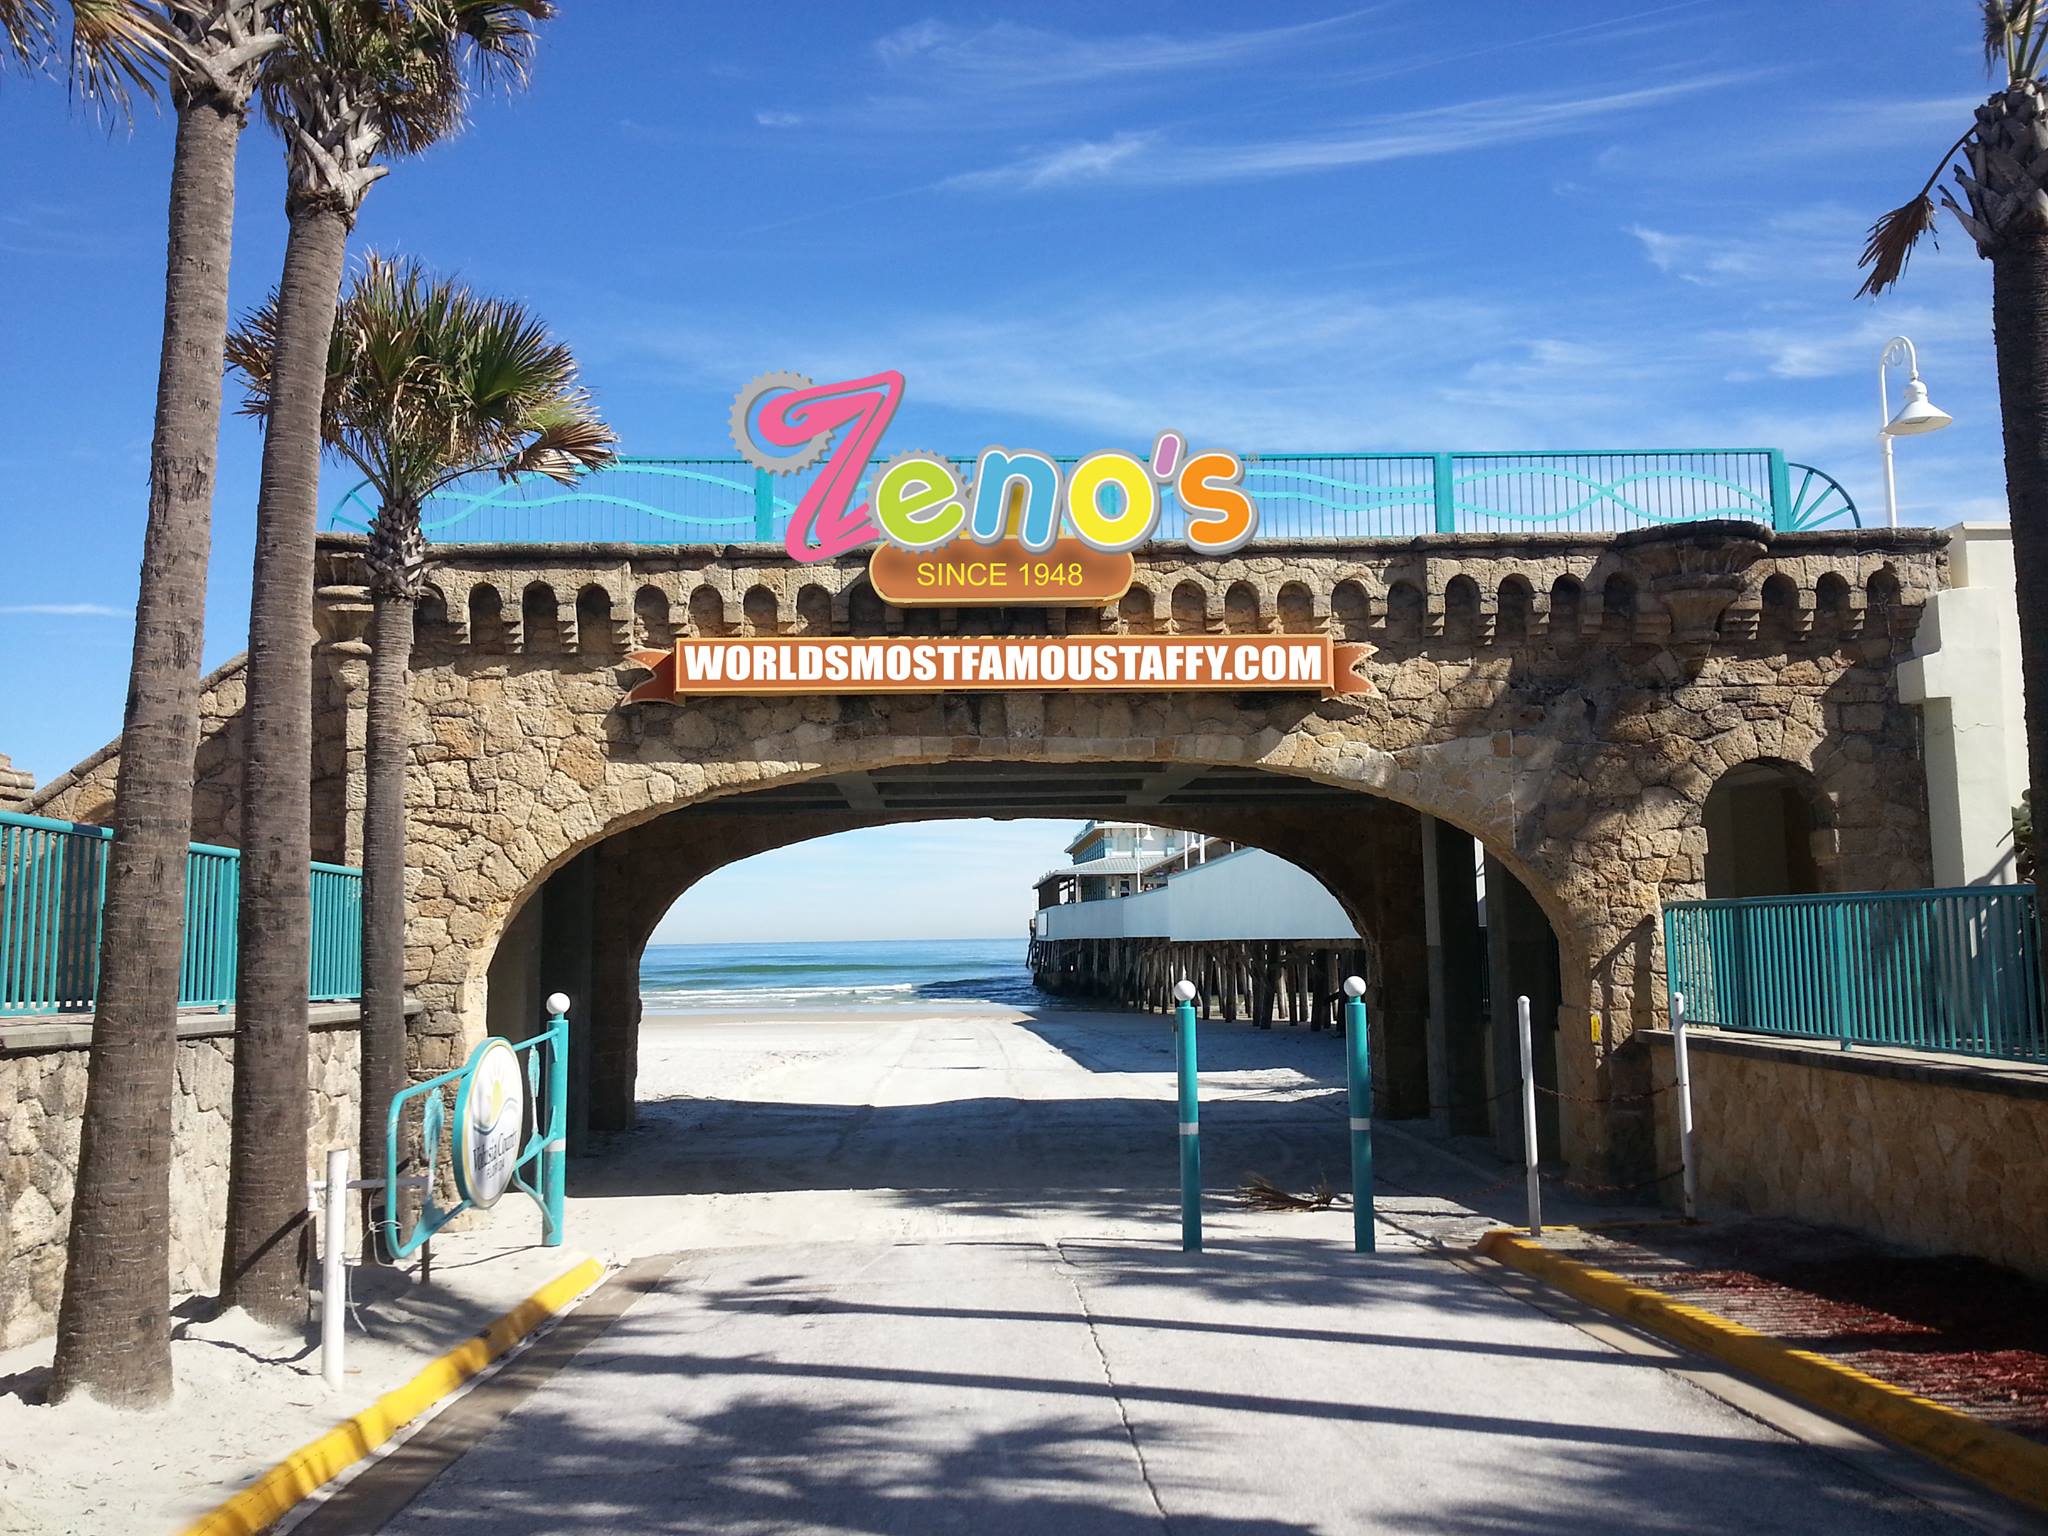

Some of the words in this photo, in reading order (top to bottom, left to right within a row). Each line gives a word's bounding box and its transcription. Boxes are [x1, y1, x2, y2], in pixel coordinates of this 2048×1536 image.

[755, 370, 1257, 561] Zeno's
[916, 562, 1007, 587] SINCE
[1019, 562, 1084, 587] 1948
[685, 643, 1323, 683] WORLDSMOSTFAMOUSTAFFY.COM
